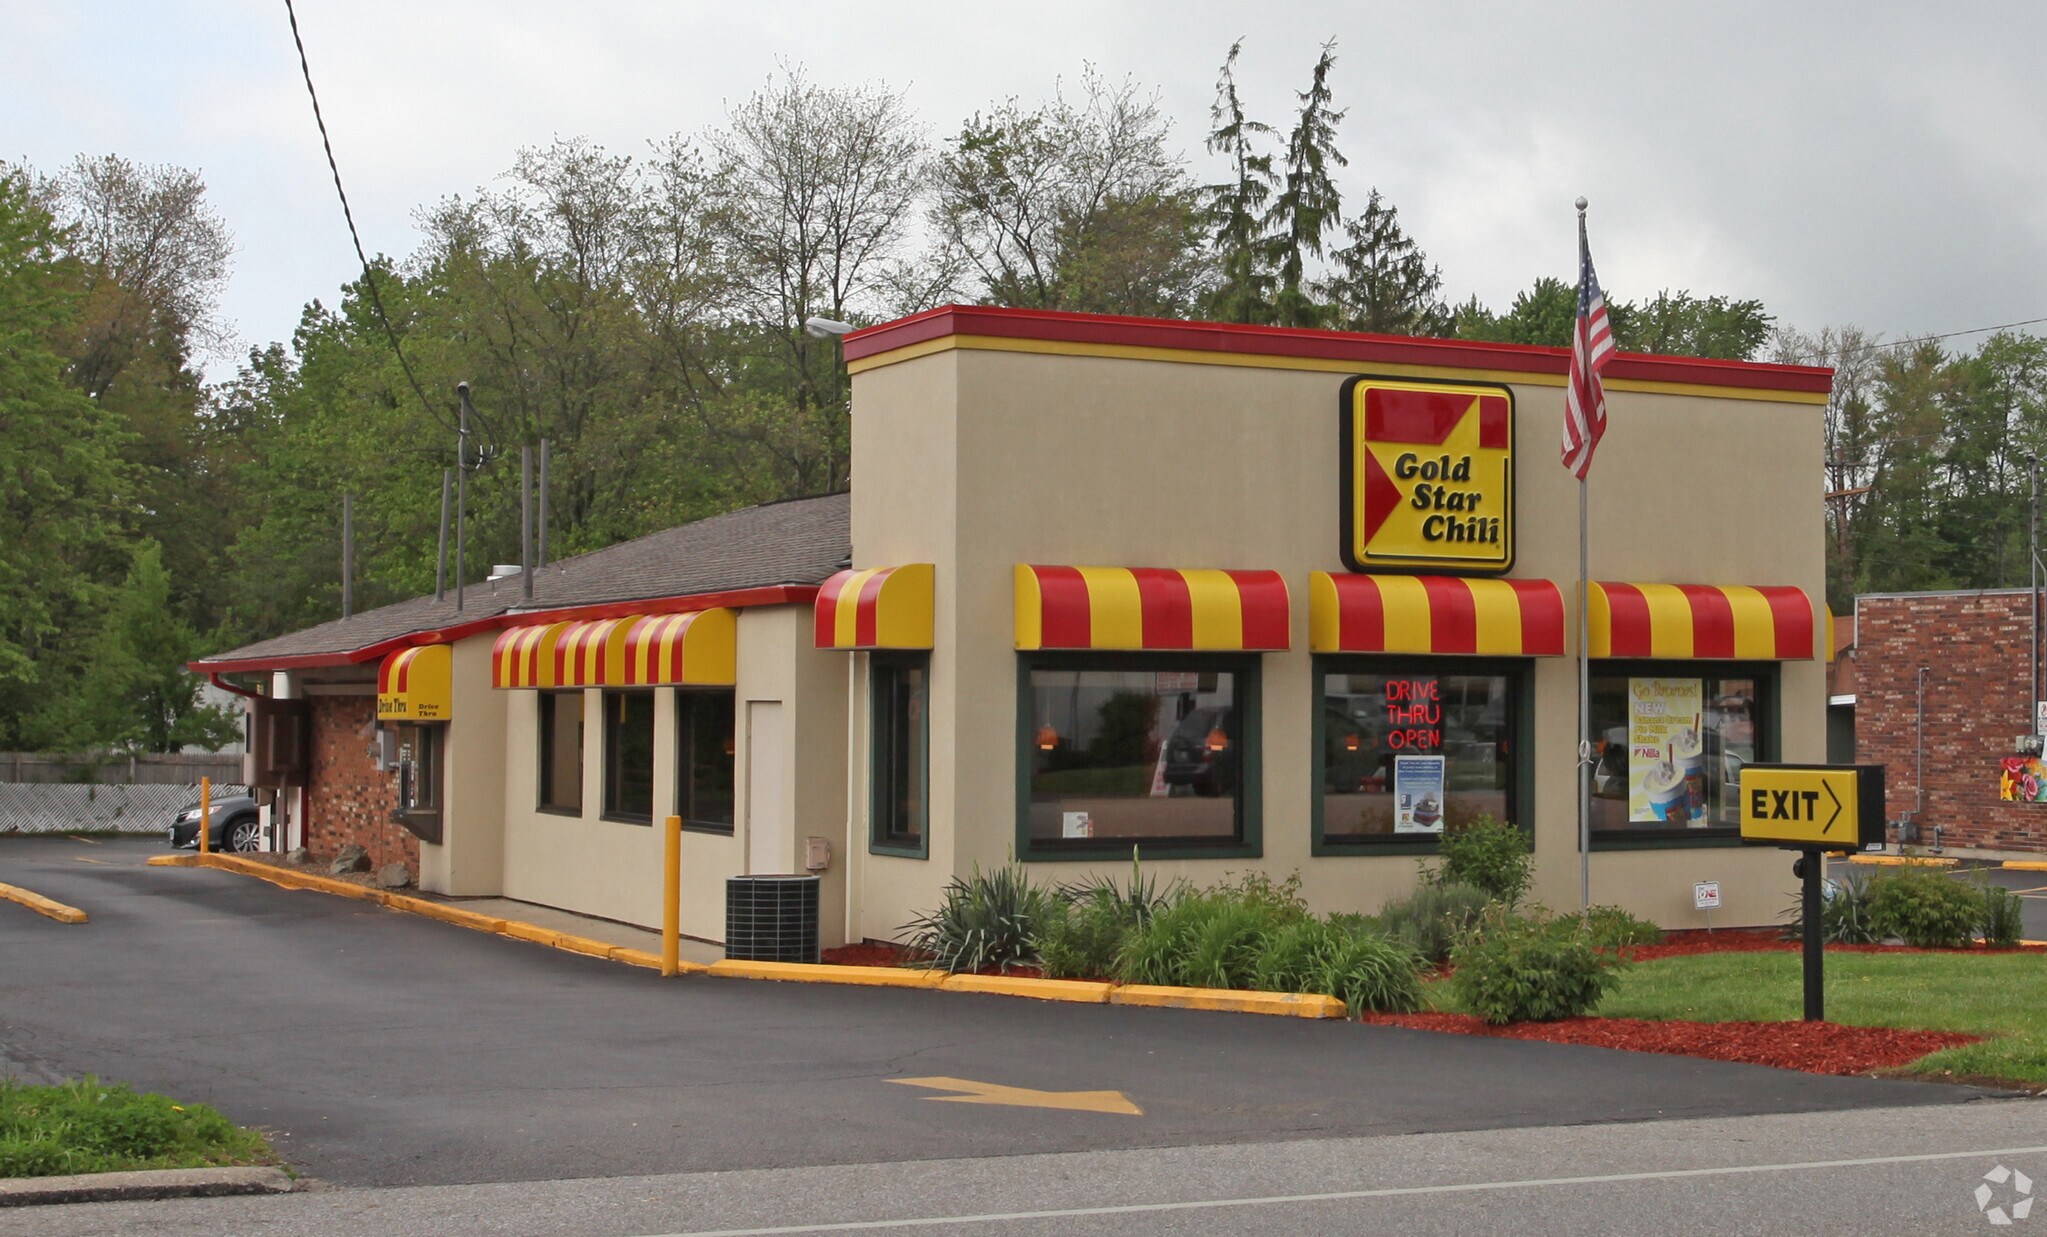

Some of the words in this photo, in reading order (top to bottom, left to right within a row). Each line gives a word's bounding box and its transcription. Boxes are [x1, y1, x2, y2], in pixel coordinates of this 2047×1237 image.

[1394, 452, 1471, 482] Gold
[1411, 483, 1482, 512] Star
[1422, 514, 1500, 543] Chili
[1386, 680, 1440, 701] DRIVE
[1633, 681, 1650, 699] Go
[379, 699, 392, 713] Drive
[394, 699, 407, 713] Thru
[1386, 704, 1441, 725] THRU
[1634, 701, 1666, 714] NEW
[1388, 729, 1440, 749] OPEN
[1642, 748, 1660, 758] Nilla
[1751, 789, 1819, 821] EXIT
